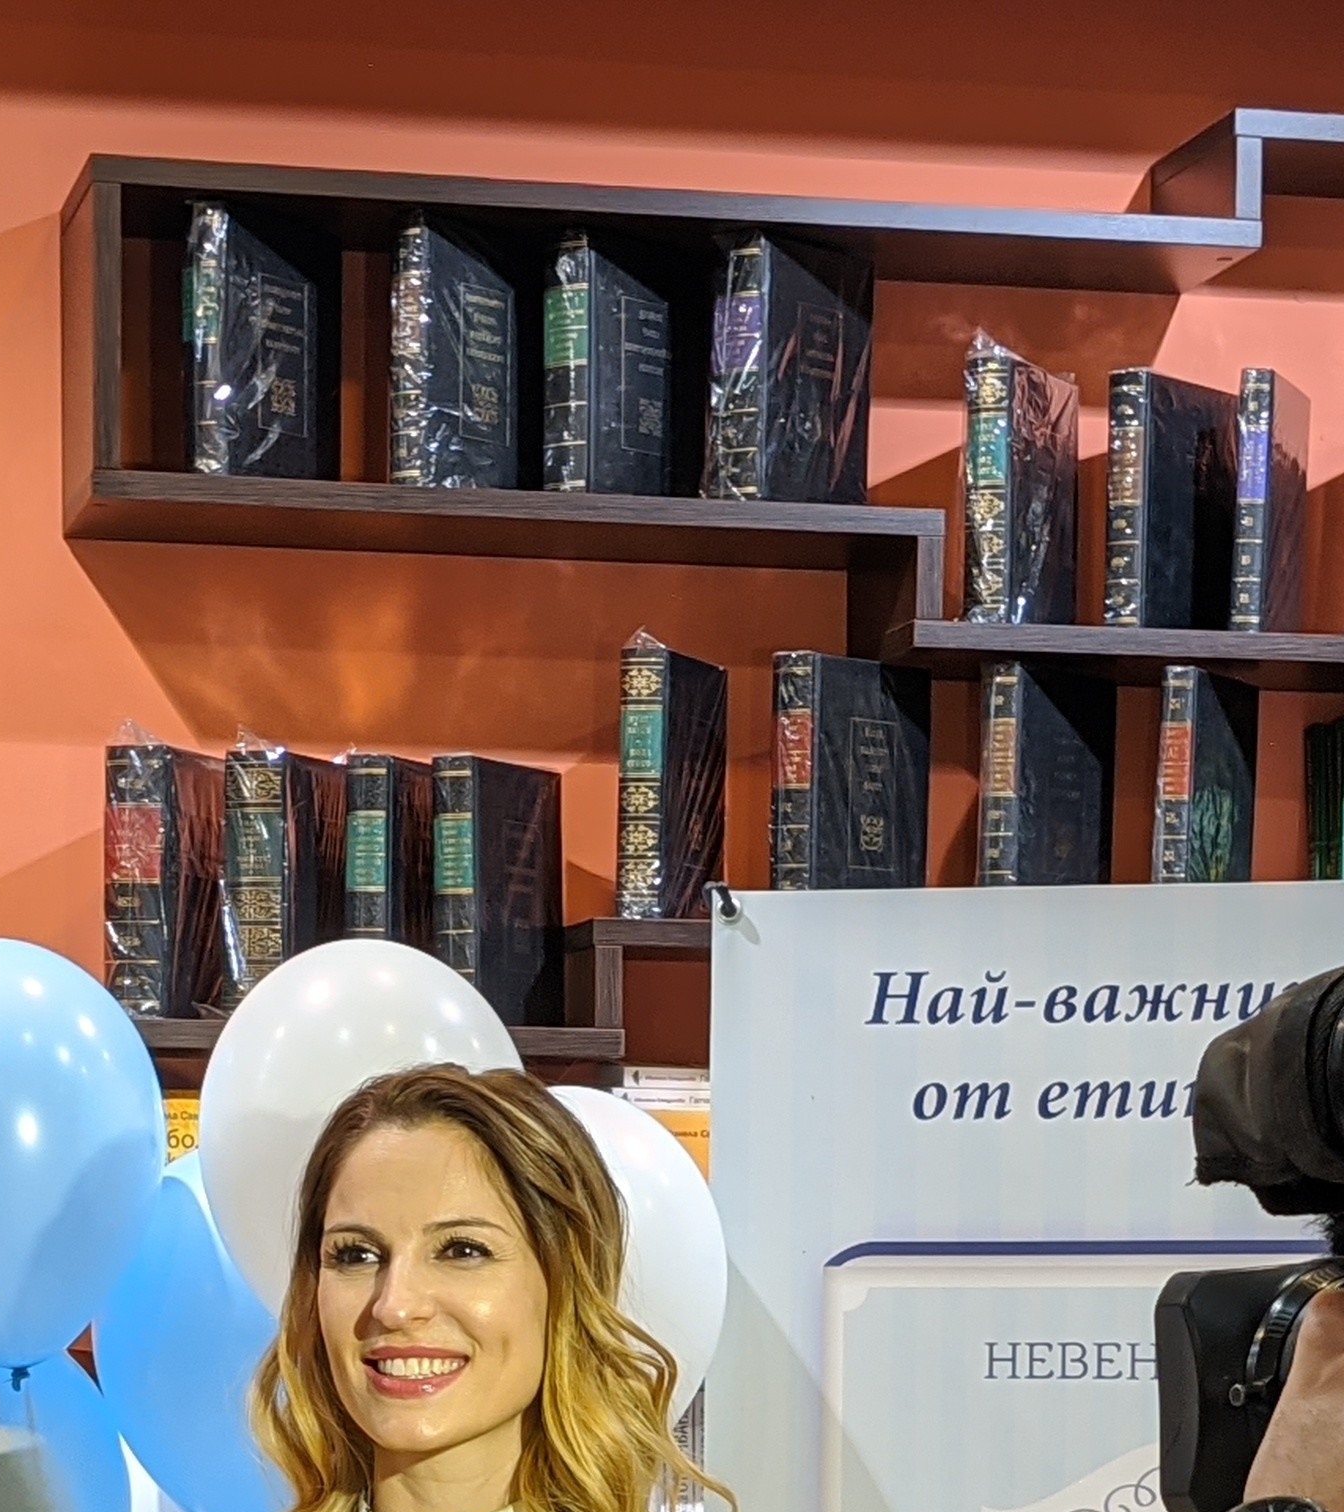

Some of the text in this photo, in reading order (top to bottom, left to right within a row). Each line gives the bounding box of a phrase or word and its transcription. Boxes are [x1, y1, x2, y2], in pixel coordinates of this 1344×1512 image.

[864, 970, 1301, 1026] Най-важни
[912, 1079, 1012, 1121] от
[984, 1342, 1158, 1380] НЕВЕН
